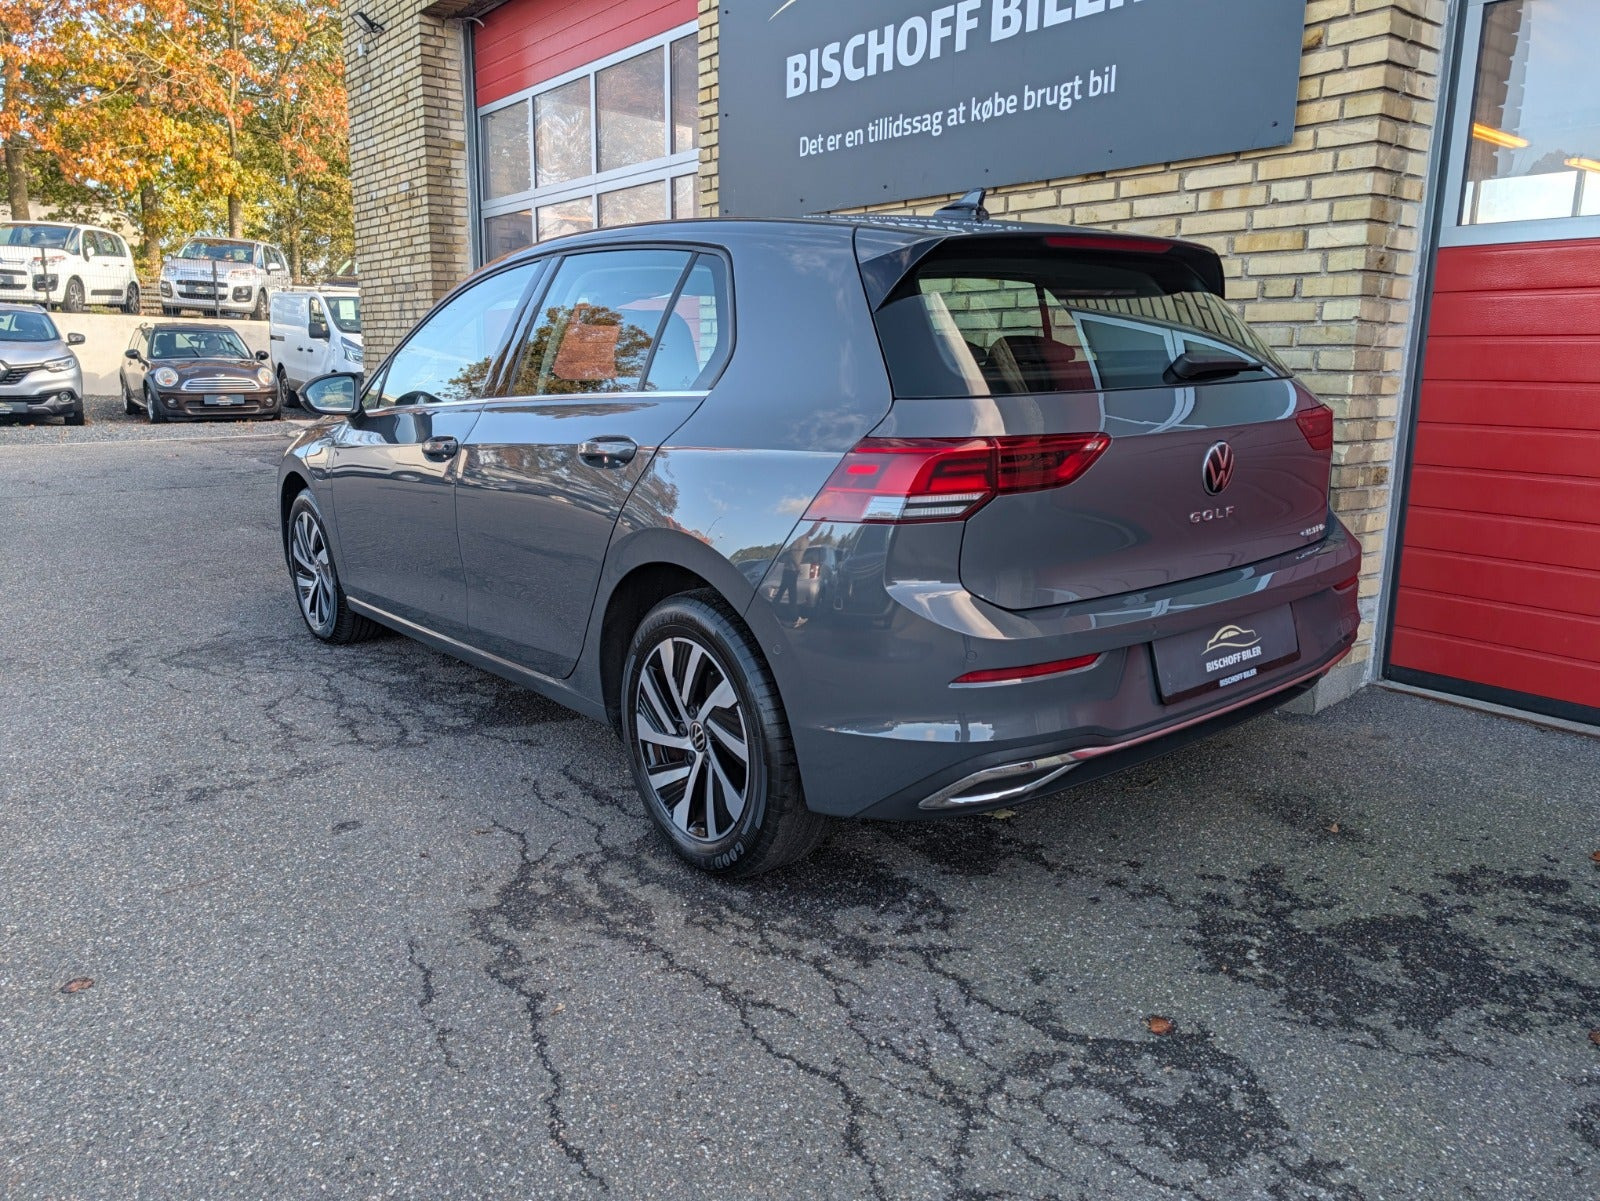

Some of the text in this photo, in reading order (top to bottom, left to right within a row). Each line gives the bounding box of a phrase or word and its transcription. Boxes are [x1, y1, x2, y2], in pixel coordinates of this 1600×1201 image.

[786, 0, 980, 98] BISCHOFF
[799, 64, 1117, 157] Det er en tillidssag at købe brugt bil
[1189, 505, 1235, 523] GOLF
[1206, 652, 1242, 672] BISCHOFF
